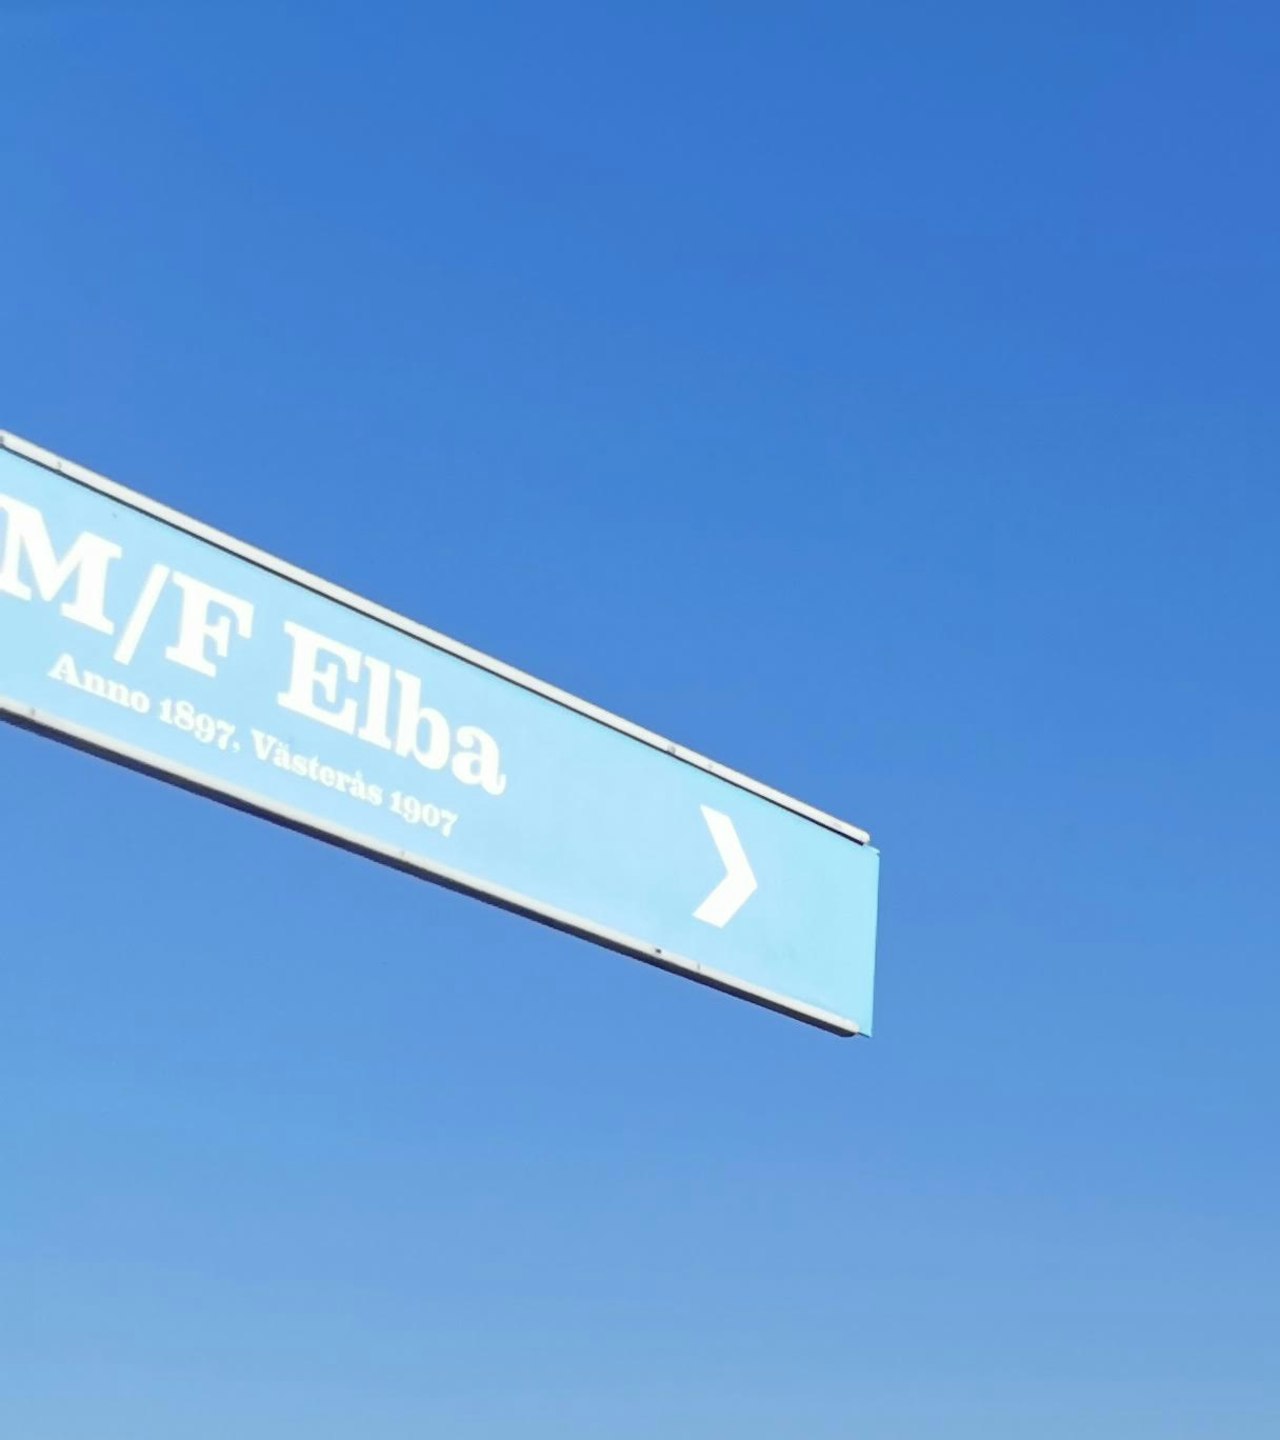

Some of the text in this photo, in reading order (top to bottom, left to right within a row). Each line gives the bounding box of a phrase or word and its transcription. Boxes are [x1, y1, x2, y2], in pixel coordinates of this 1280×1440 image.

[0, 492, 508, 796] M/F Elba
[47, 652, 460, 838] Anno 1897, Västerås 1907
